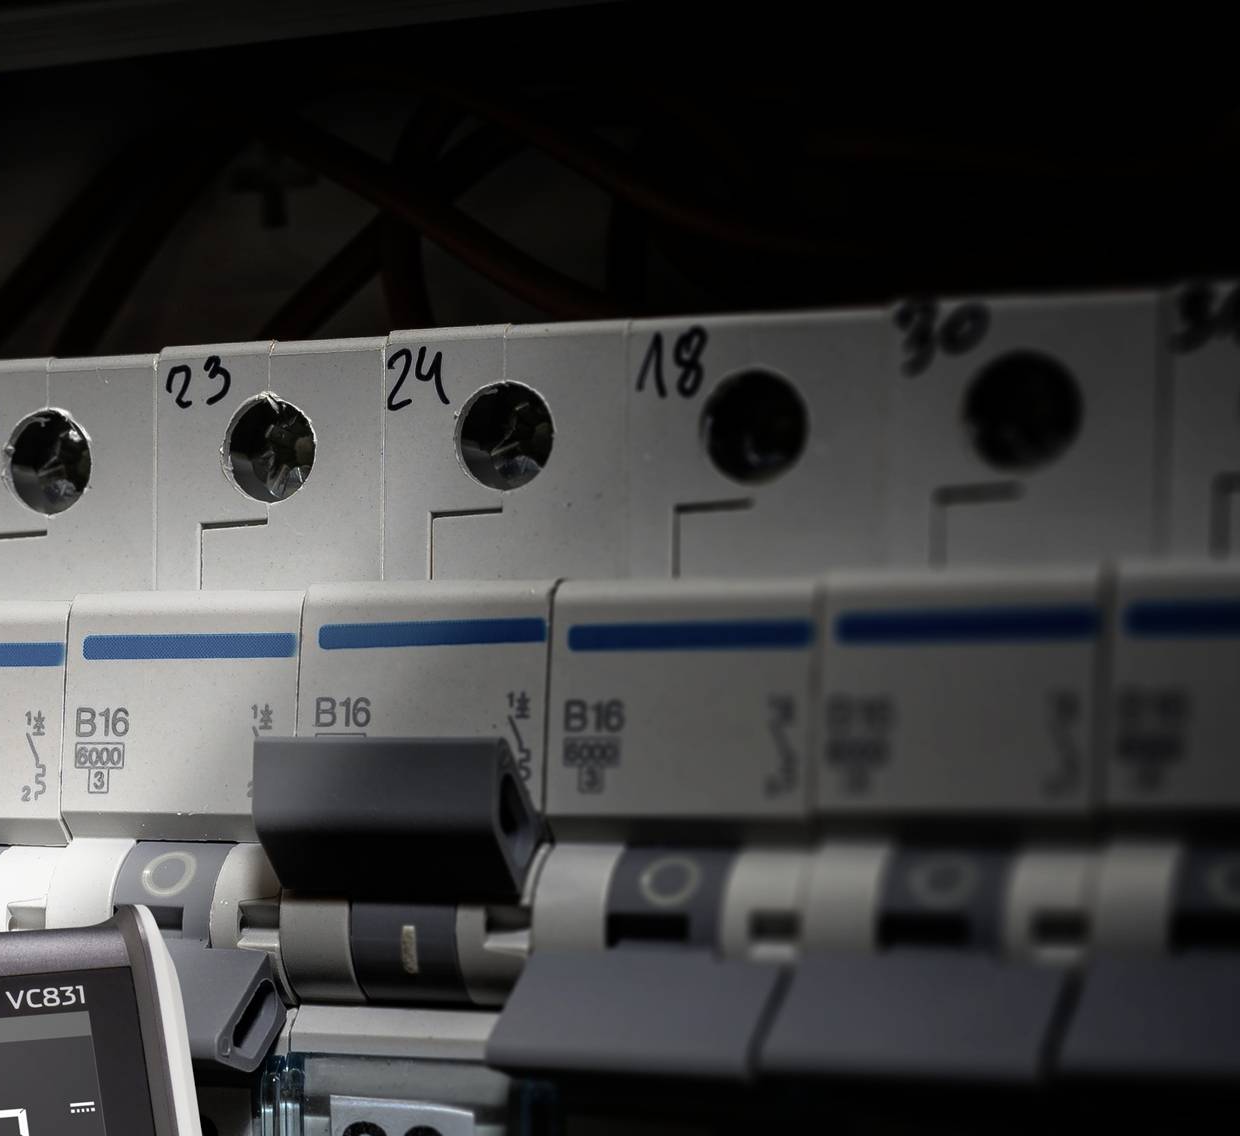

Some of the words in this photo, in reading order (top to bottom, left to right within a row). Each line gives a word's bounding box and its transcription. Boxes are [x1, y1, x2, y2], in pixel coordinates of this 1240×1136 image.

[636, 326, 708, 398] 18
[165, 355, 232, 409] 23
[386, 346, 451, 412] 24
[24, 711, 32, 727] 1
[75, 707, 130, 738] B16
[314, 696, 372, 728] B16
[563, 698, 626, 734] B16
[76, 746, 122, 767] 6000
[21, 785, 31, 802] 2
[93, 771, 105, 790] 3
[5, 985, 87, 1010] VC831
